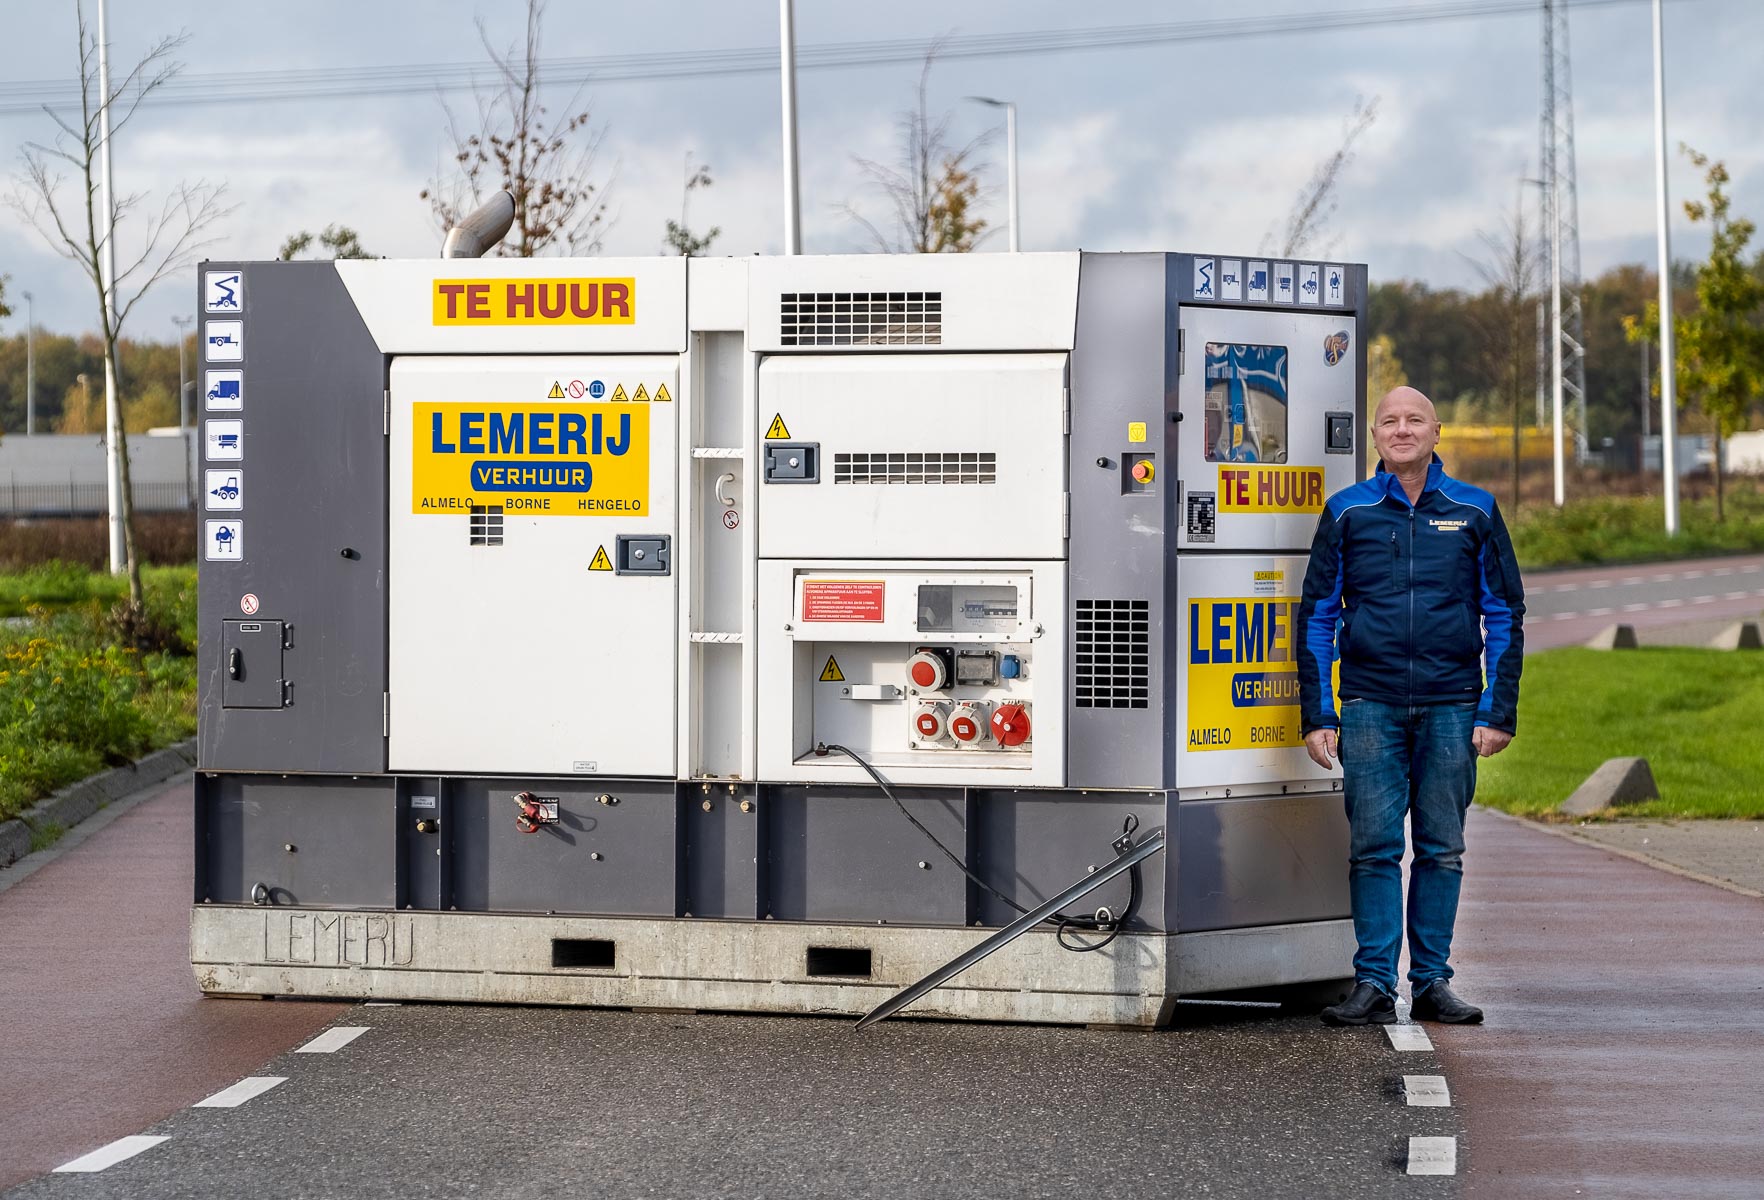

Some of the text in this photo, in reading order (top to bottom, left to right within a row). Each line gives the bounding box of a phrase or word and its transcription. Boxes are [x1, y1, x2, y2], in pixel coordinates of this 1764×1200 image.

[438, 283, 630, 319] TE HUUR
[432, 412, 631, 456] LEMERIJ
[477, 468, 586, 486] VERHUUR
[1221, 471, 1324, 508] TE HUUR
[421, 497, 641, 511] ALMELO BORNE HENGELO
[1190, 602, 1300, 665] LEME
[1234, 680, 1300, 700] VERHUUR
[1189, 727, 1232, 746] ALMELO
[1250, 726, 1286, 743] BORNE
